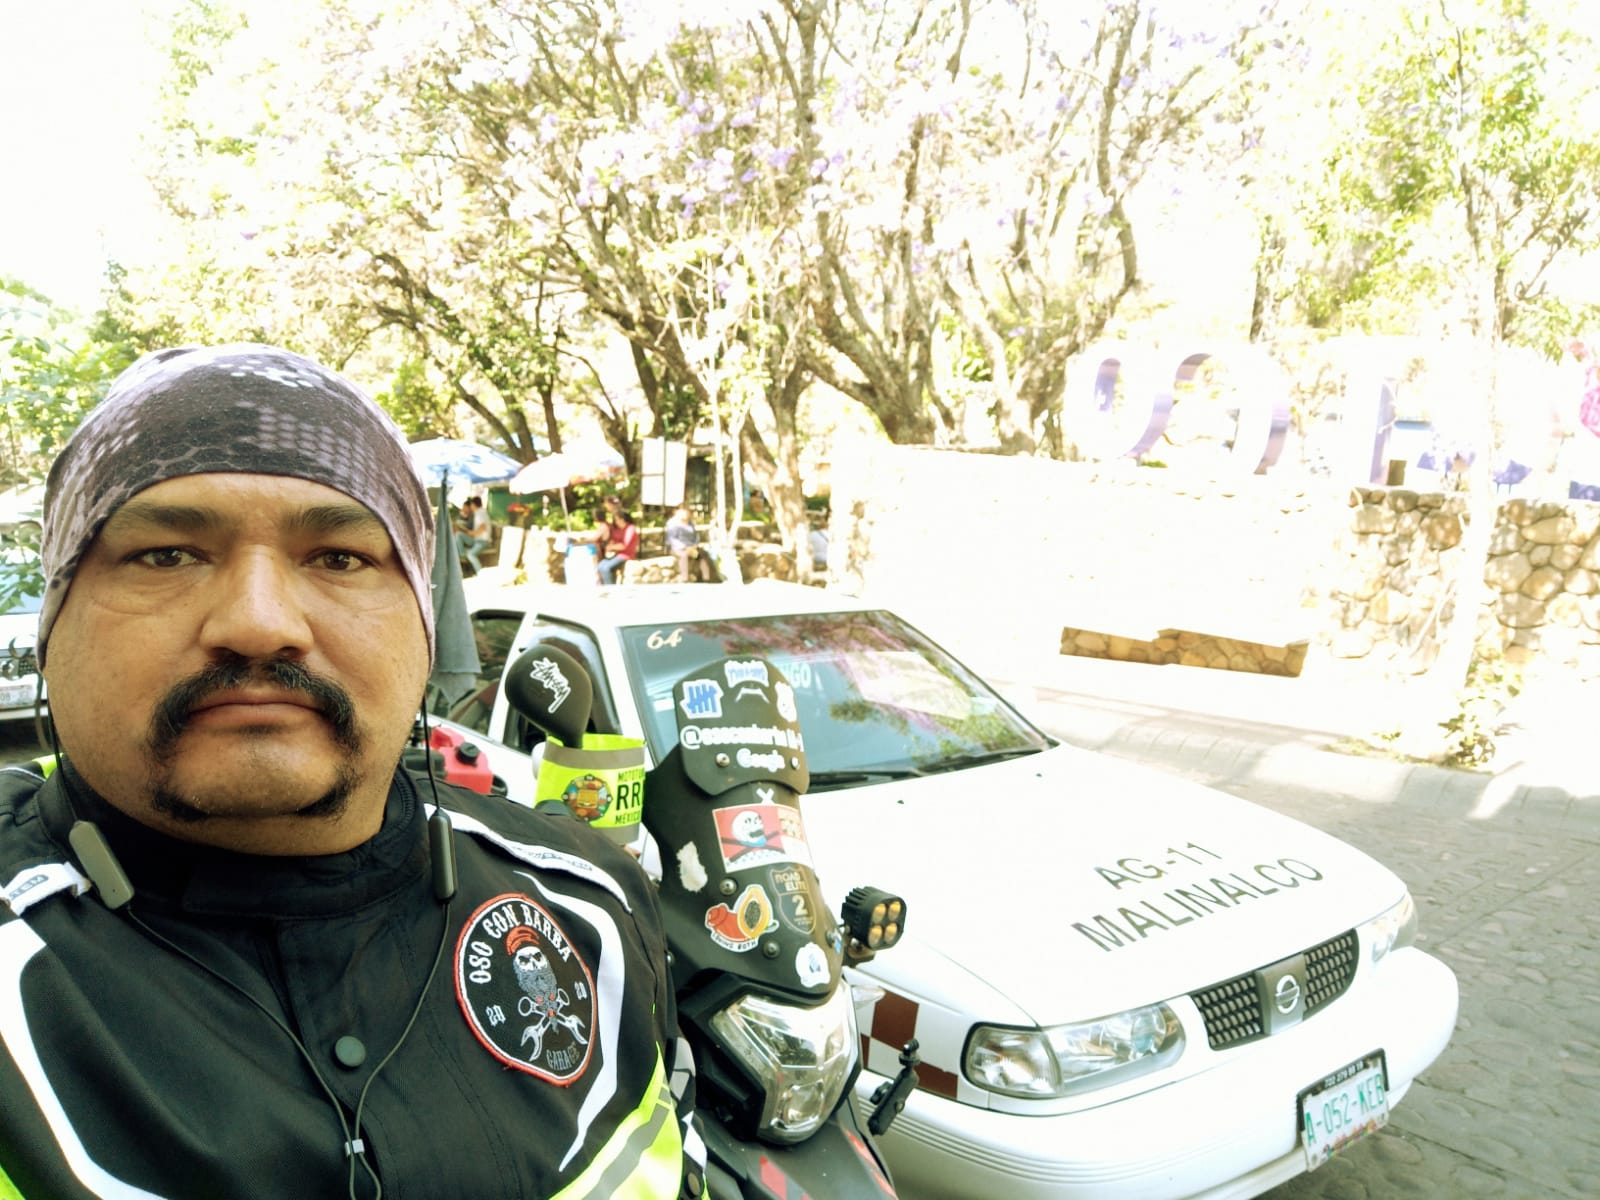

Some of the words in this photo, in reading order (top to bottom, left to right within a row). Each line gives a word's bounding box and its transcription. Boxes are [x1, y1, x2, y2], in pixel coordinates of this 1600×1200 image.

[647, 628, 684, 650] 64
[616, 781, 641, 811] RR
[1094, 842, 1222, 890] AG-11
[792, 895, 808, 916] 2
[1071, 858, 1323, 952] MALINALCO
[469, 941, 493, 983] OSO
[482, 904, 521, 938] CON
[520, 904, 572, 962] BARBA
[1305, 1073, 1385, 1147] A-052-KEB
